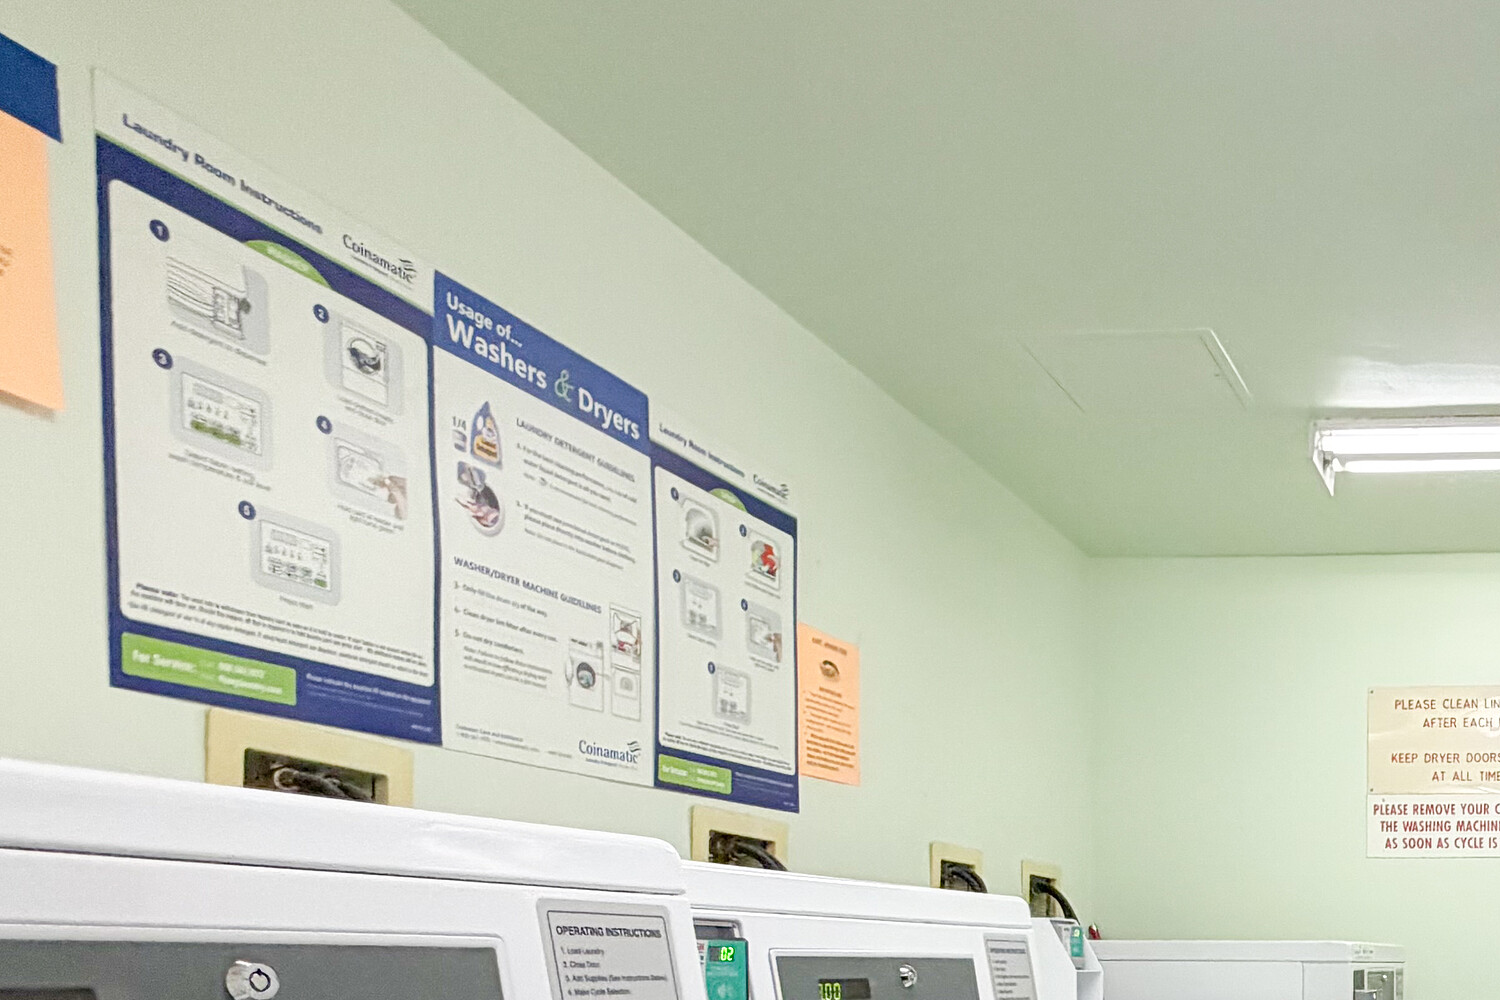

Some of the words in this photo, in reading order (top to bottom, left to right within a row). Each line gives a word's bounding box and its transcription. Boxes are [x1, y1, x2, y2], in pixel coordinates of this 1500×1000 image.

[122, 113, 189, 162] Laundry
[195, 154, 236, 186] Room
[240, 178, 324, 235] Instructions
[342, 234, 416, 285] Coinamatic
[446, 291, 493, 331] Usage
[496, 324, 524, 349] of...
[446, 313, 549, 391] Washers
[554, 369, 575, 403] &
[578, 386, 641, 440] Dryers
[454, 556, 520, 586] WASHER/DRYER
[522, 580, 559, 601] MACHINE
[560, 592, 602, 614] GUIDELINES
[1394, 698, 1437, 711] PLEASE
[1442, 698, 1478, 709] CLEAN
[1423, 717, 1457, 728] AFTER
[1463, 717, 1493, 728] EACH
[578, 739, 640, 764] Coinamatic
[1391, 753, 1418, 764] KEEP
[1424, 753, 1460, 764] DRYER
[1432, 771, 1446, 782] AT
[1452, 771, 1473, 782] ALL
[1373, 803, 1409, 816] PLEASE
[1412, 803, 1456, 816] REMOVE
[1460, 803, 1490, 815] YOUR
[1380, 820, 1398, 833] THE
[1402, 820, 1451, 833] WASHING
[1385, 837, 1398, 849] AS
[1402, 837, 1432, 849] SOON
[1436, 837, 1449, 849] AS
[1454, 837, 1485, 849] CYCLE
[1488, 837, 1498, 849] IS
[556, 925, 604, 937] OPERATING
[605, 927, 662, 938] INSTRUCTIONS
[720, 946, 735, 962] 02
